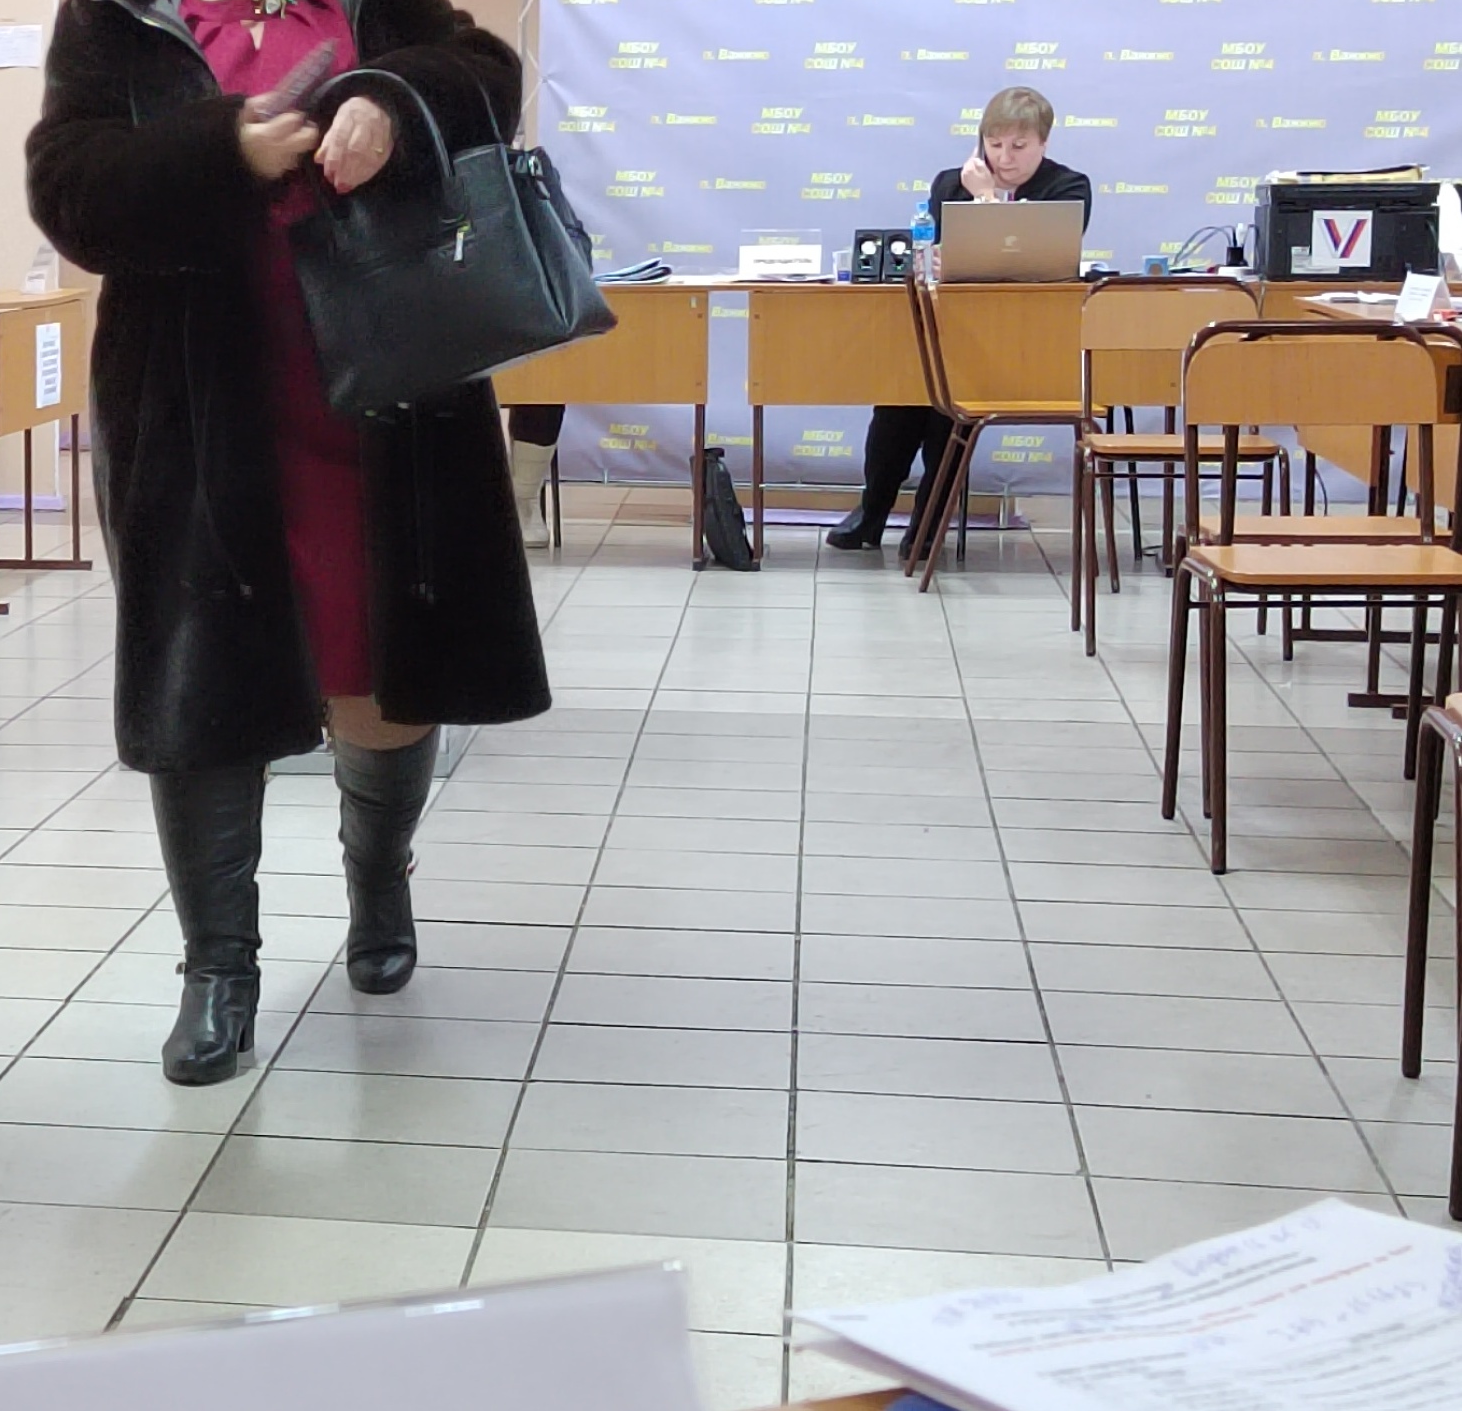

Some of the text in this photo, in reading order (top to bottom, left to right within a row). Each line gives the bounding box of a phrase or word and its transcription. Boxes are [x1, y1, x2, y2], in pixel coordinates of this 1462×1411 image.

[1015, 42, 1058, 53] МБОУ
[1221, 43, 1265, 54] МБОУ
[1006, 58, 1038, 69] СОШ
[1212, 59, 1245, 70] СОШ
[1164, 110, 1208, 121] МБОУ
[1374, 111, 1419, 122] МБОУ
[1155, 126, 1188, 137] СОШ
[1365, 127, 1399, 138] СОШ
[1002, 435, 1044, 446] МБОУ
[993, 451, 1025, 461] СОШ
